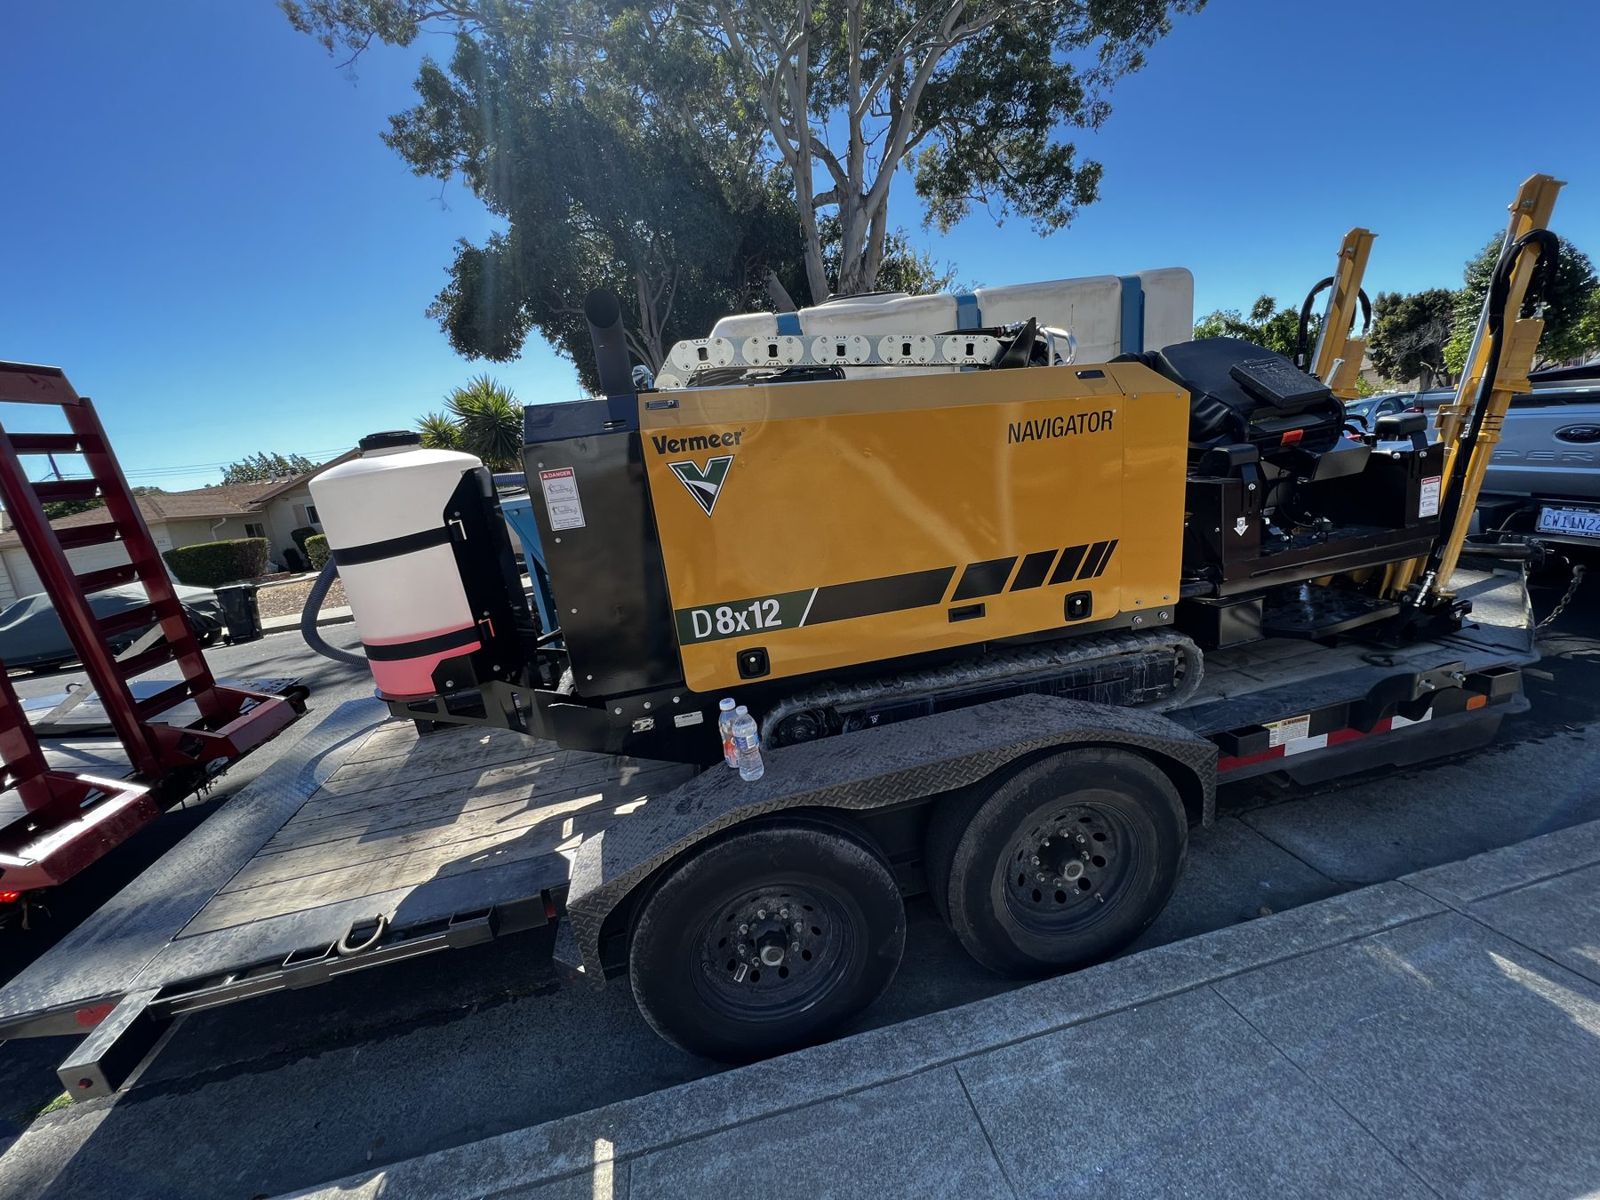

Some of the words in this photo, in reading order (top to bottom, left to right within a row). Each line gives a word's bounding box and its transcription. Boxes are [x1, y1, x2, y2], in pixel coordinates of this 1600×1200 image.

[1008, 410, 1113, 444] NAVIGATOR
[652, 431, 742, 454] Vermeer
[1493, 449, 1594, 461] PER
[548, 470, 572, 479] DANGER
